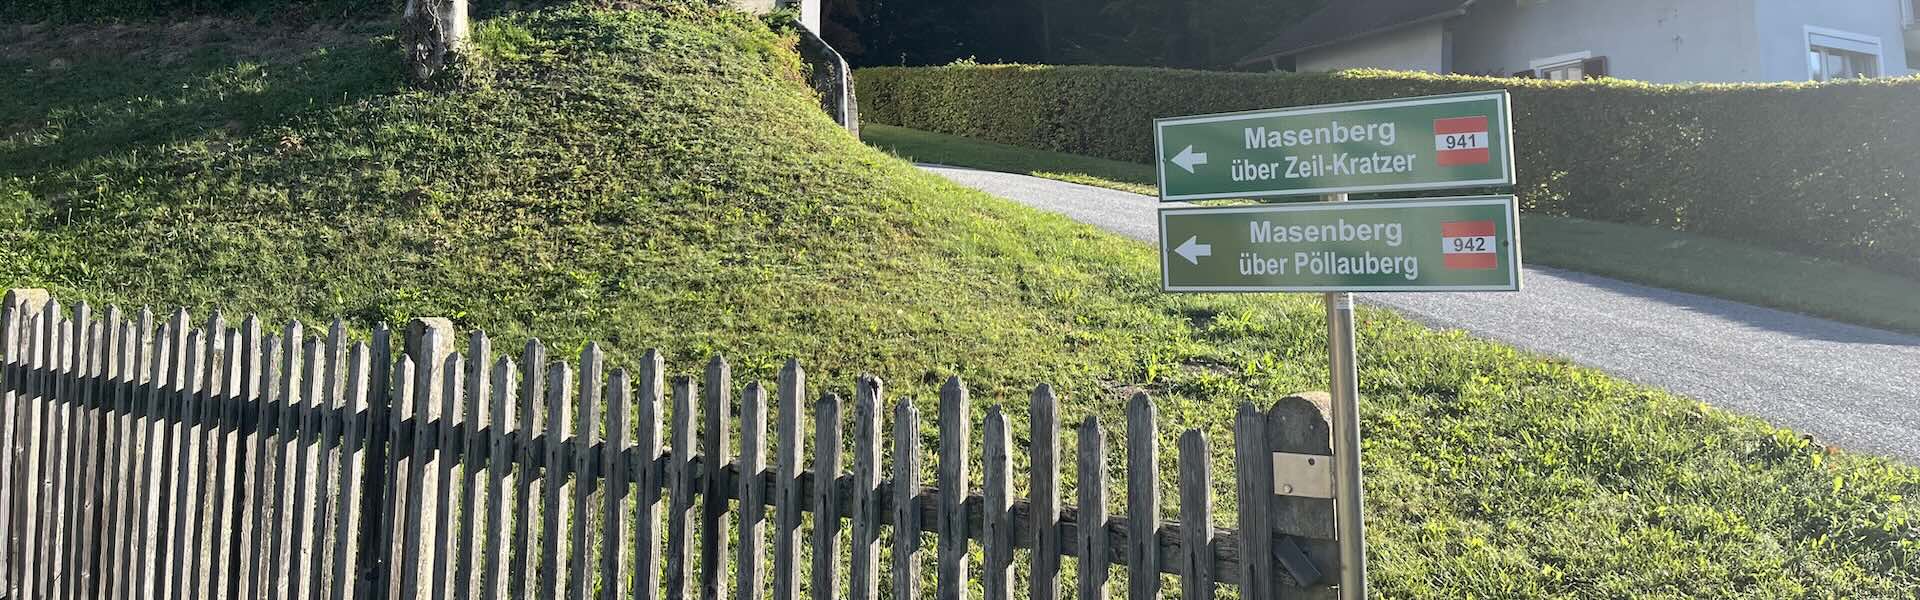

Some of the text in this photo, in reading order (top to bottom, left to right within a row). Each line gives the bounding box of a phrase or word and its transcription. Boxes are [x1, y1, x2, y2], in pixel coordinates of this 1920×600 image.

[1244, 121, 1396, 150] Masenberg
[1445, 134, 1477, 150] 941
[1231, 152, 1416, 182] über Zeil-Kratzer
[1250, 219, 1402, 246] Masenberg
[1453, 237, 1486, 252] 942
[1239, 252, 1418, 280] über Pöllauberg
